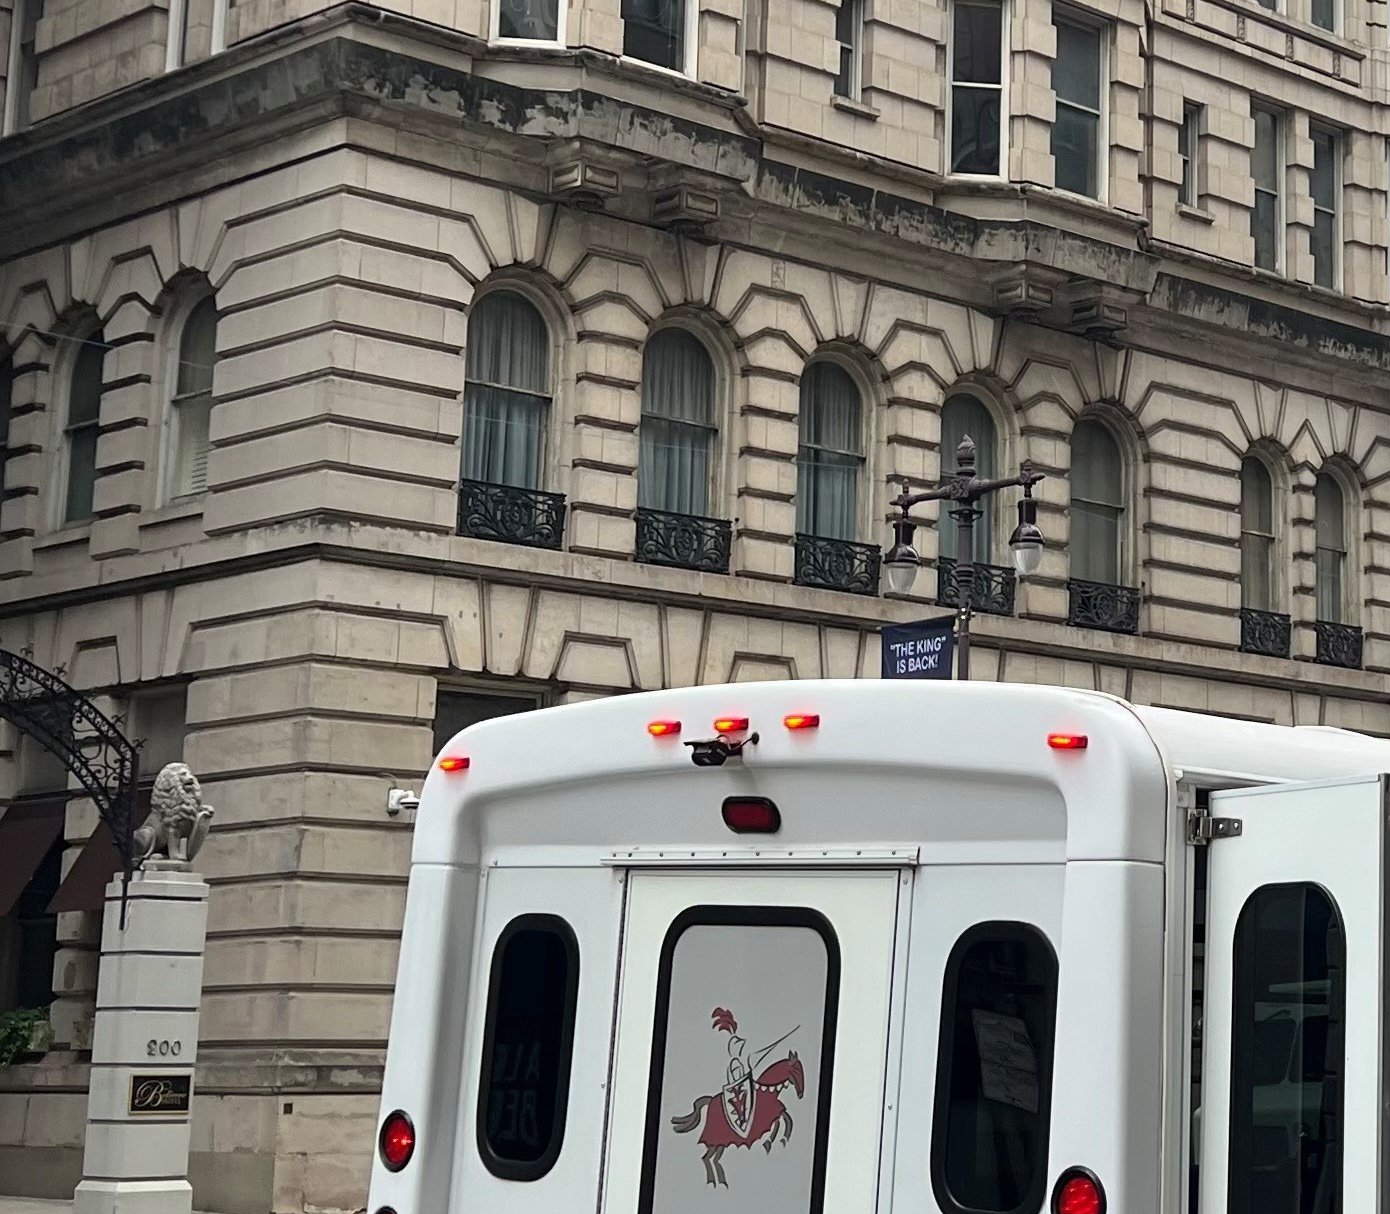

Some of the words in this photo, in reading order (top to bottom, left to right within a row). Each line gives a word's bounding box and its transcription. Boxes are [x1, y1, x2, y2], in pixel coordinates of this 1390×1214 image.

[890, 641, 915, 657] "THE
[917, 636, 947, 654] KING"
[896, 659, 906, 674] IS
[908, 654, 939, 672] BACK!
[146, 1039, 182, 1056] 200
